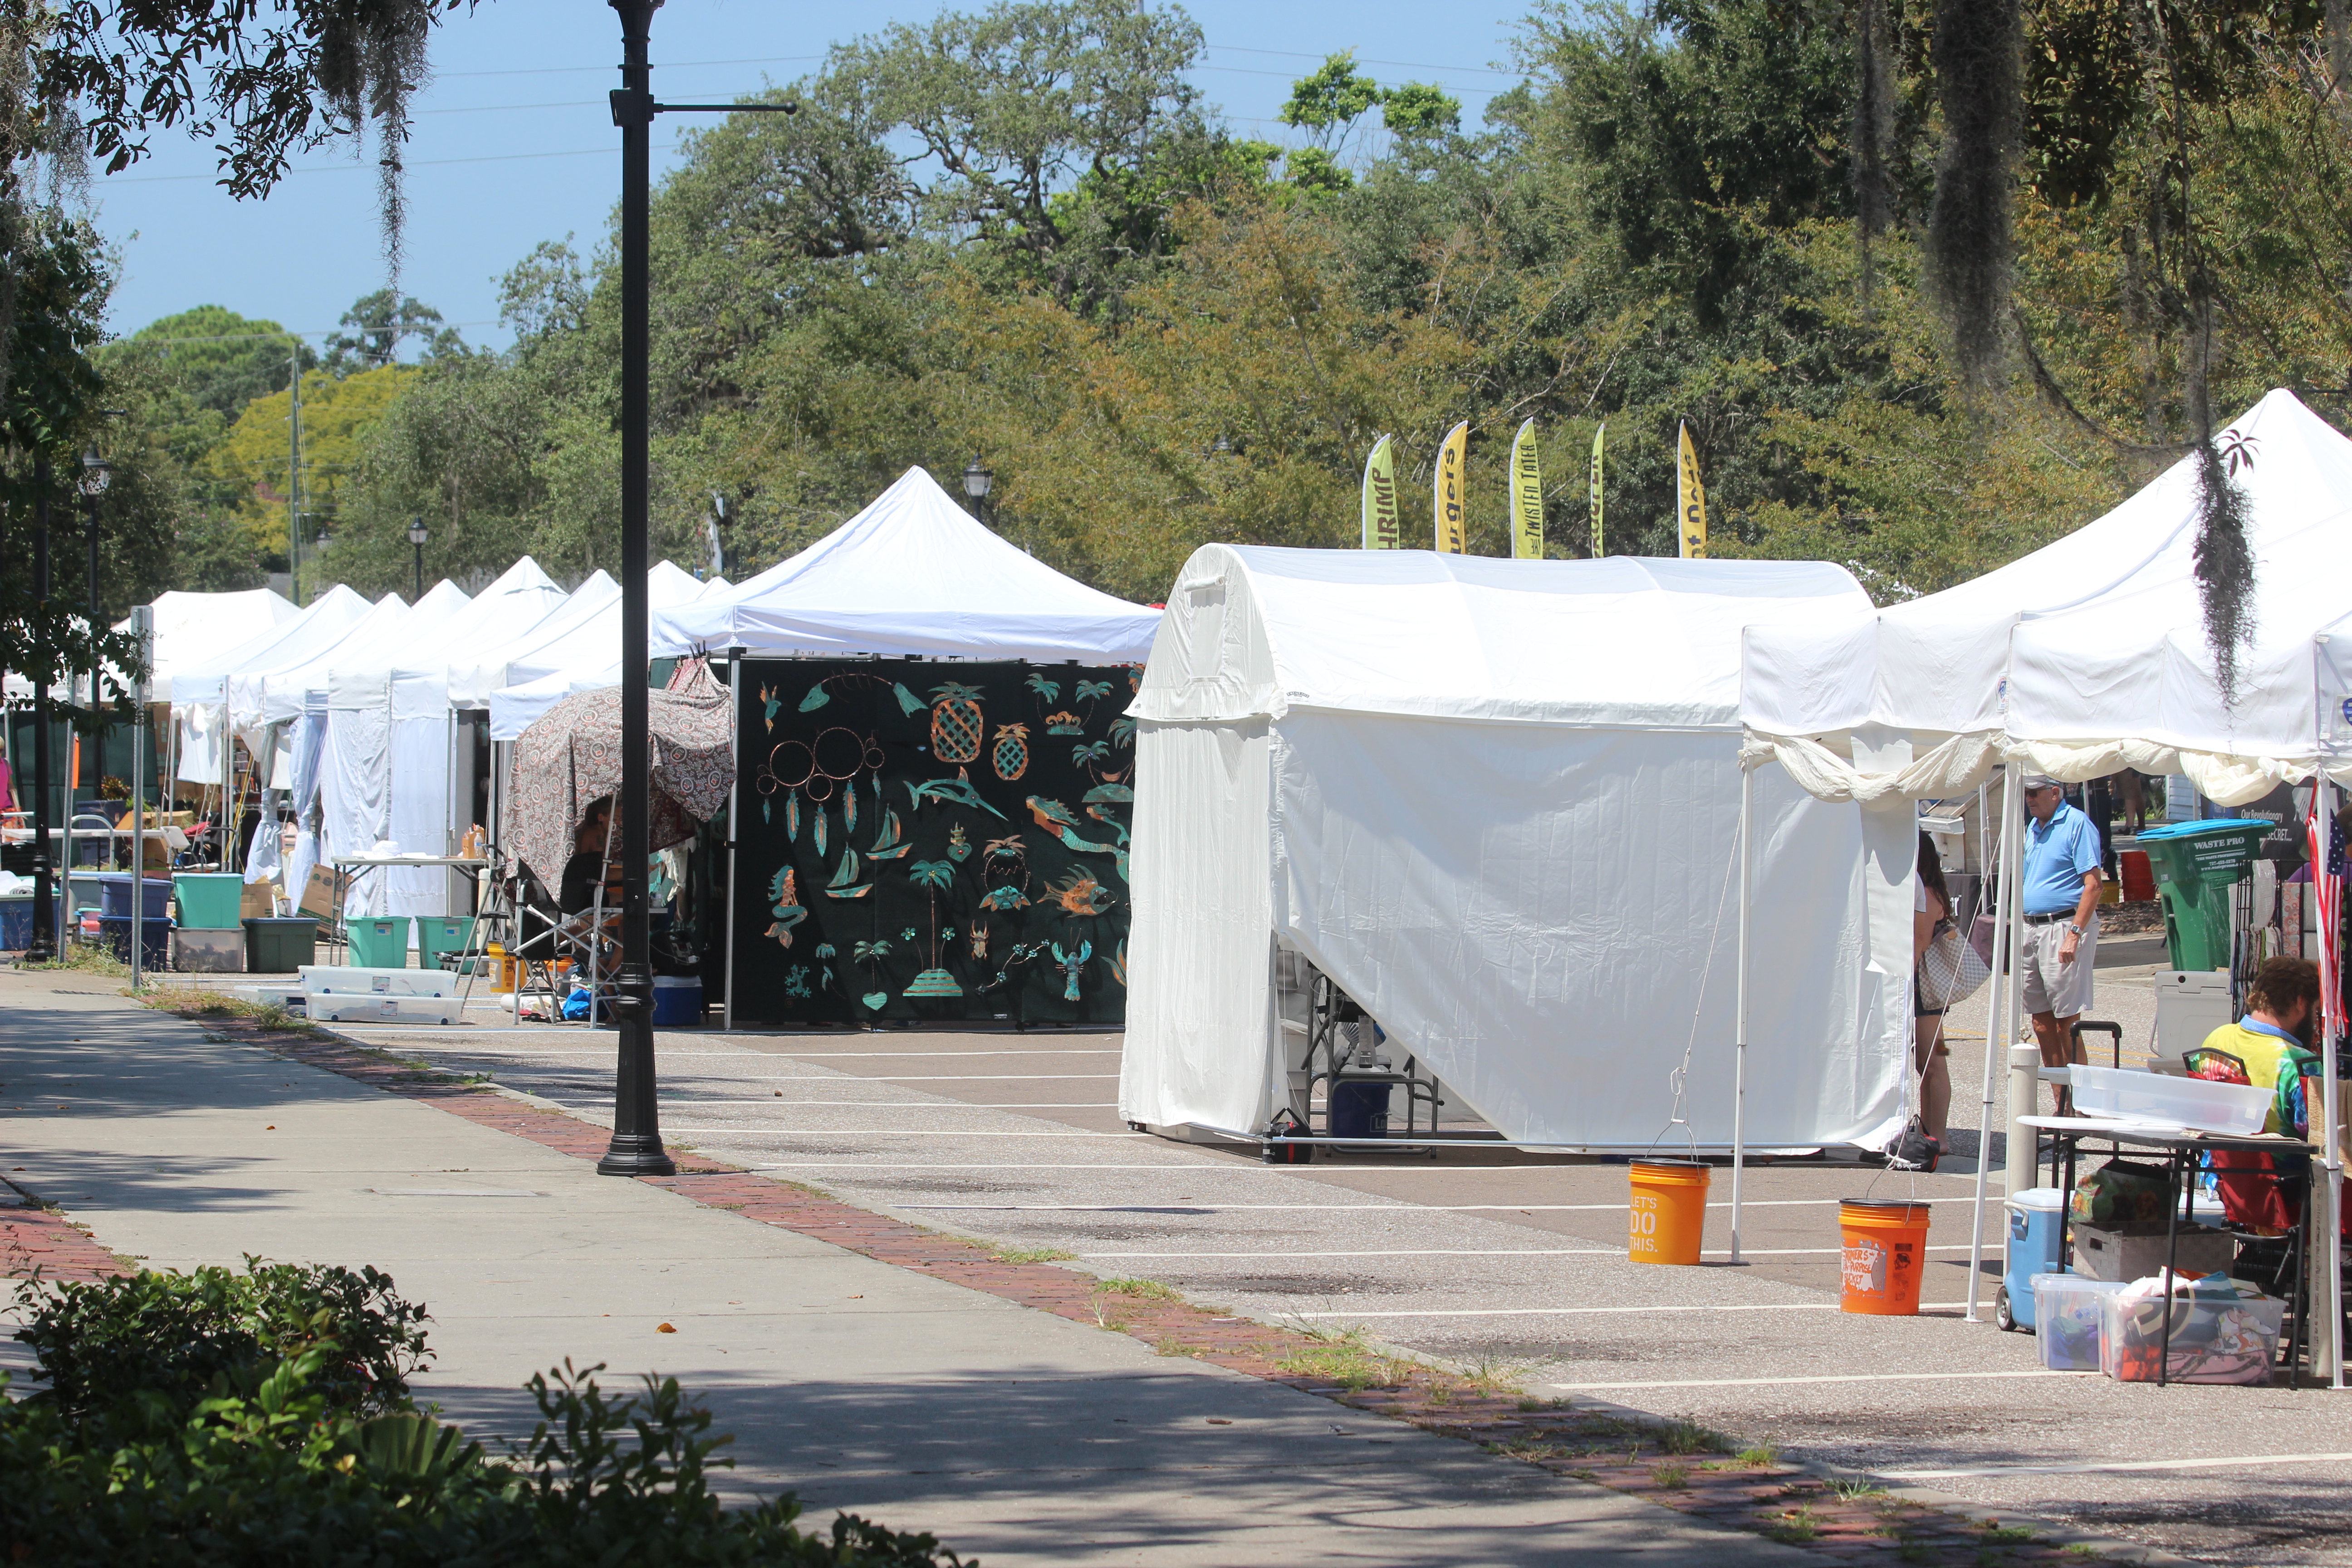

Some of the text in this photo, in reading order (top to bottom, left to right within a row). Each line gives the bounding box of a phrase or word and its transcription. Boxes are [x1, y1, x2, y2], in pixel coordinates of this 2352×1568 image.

[1520, 444, 1538, 479] TATER
[1523, 485, 1540, 537] TWISTED
[2241, 809, 2283, 823] Our Revolutionary
[2194, 837, 2245, 849] WASTE PRO
[1631, 1196, 1657, 1209] LET'S
[1630, 1210, 1656, 1235] DO
[1630, 1236, 1658, 1252] THIS.
